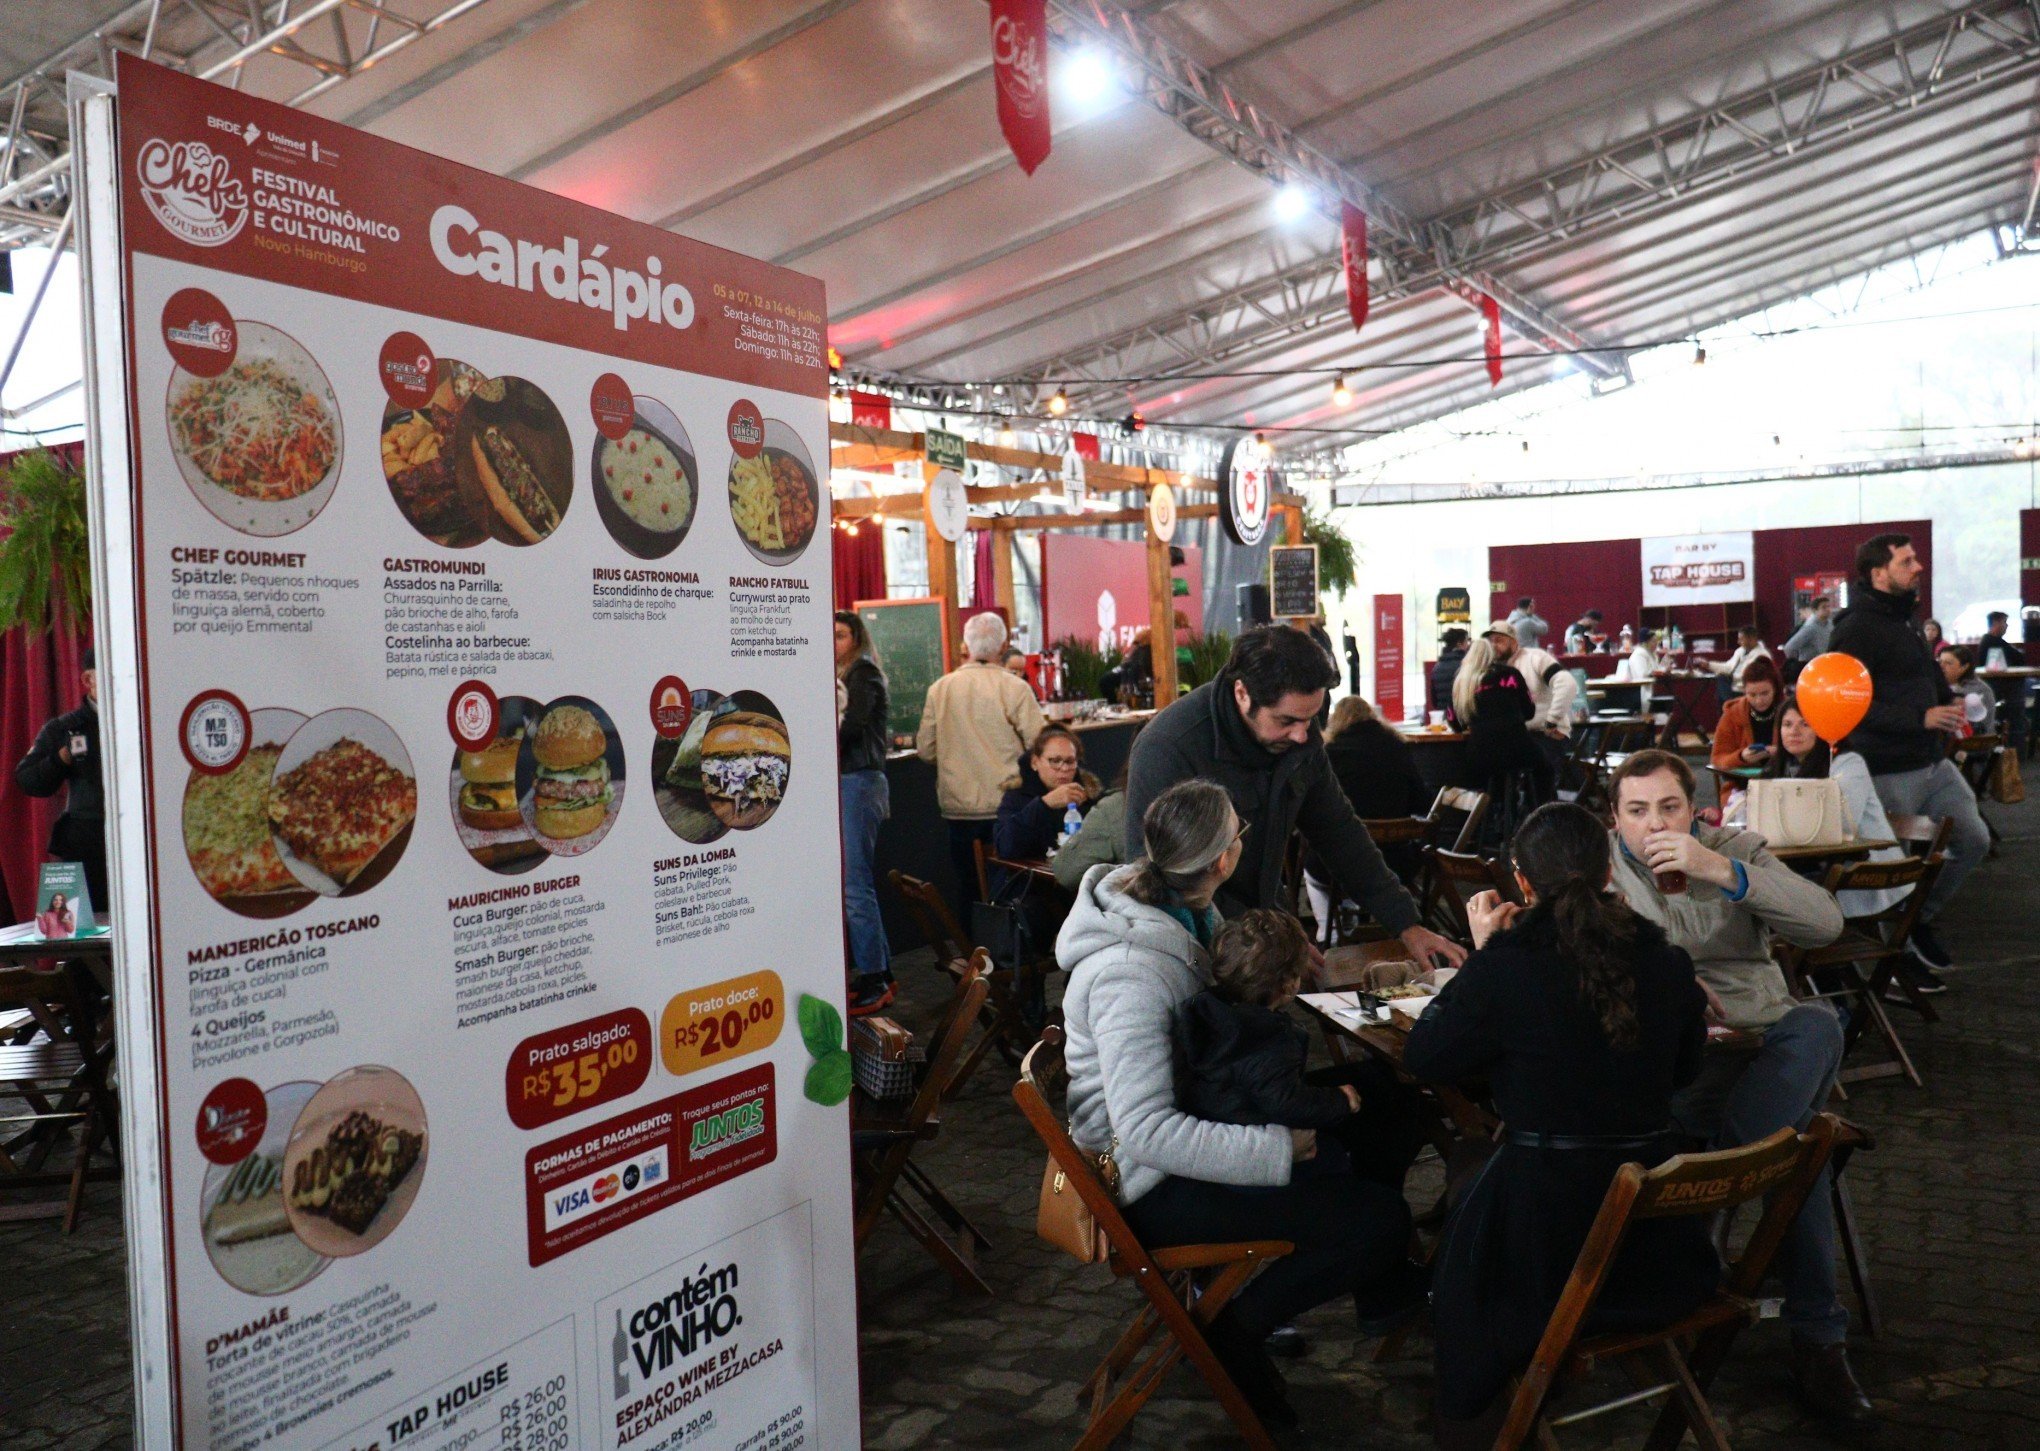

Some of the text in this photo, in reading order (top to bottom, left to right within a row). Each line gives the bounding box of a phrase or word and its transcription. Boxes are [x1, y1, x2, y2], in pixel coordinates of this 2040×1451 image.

[207, 115, 242, 136] BRDE
[267, 131, 306, 151] Unimed
[252, 167, 340, 207] FESTIVAL
[160, 204, 227, 239] GOURMET
[253, 188, 400, 243] GASTRONÔMICO
[254, 212, 366, 254] E CULTURAL
[254, 234, 367, 273] Novo Hamburgo
[429, 205, 695, 331] Cardápio
[713, 283, 822, 324] 05 a 07, 12 a 14 de julho
[724, 306, 820, 341] Sexta-feira: 17h às 22h;
[734, 338, 823, 368] Domingo: 11h às 22h.
[740, 325, 820, 355] Sábado: 11h às 22h;
[733, 425, 759, 442] RANCHO
[928, 434, 962, 457] SAÍDA
[171, 548, 306, 568] CHEF GOURMET
[383, 558, 486, 575] GASTROMUNDI
[1652, 563, 1743, 579] TAP HOUSE
[172, 570, 360, 591] Spätzle: Pequenos nhoques
[384, 577, 504, 592] Assados na Parrilla:
[592, 569, 700, 583] IRIUS GASTRONOMIA
[729, 577, 809, 589] RANCHO FATBULL
[172, 587, 320, 602] de massa, servido com
[384, 592, 510, 607] Churrasquinho de carne,
[592, 584, 714, 600] Escondidinho de charque:
[729, 592, 810, 605] Currywurst ao prato
[1441, 597, 1464, 610] BALY
[172, 603, 325, 618] linguiça alemã, coberto
[592, 610, 666, 620] com salsicha Bock
[174, 620, 312, 634] por queijo Emmental
[384, 635, 530, 648] Costelinha ao barbecue:
[730, 635, 808, 648] Acompanha batatinha
[730, 647, 756, 656] crinkle
[762, 646, 796, 656] mostarda
[653, 847, 736, 872] SUNS DA LOMBA
[654, 864, 737, 886] Suns Privilege: Pão
[448, 874, 580, 910] MAURICINHO BURGER
[453, 896, 585, 928] Cuca Burger: pão de cuca,
[187, 915, 380, 965] MANJERICÃO TOSCANO
[454, 933, 595, 972] Smash Burger: pão brioche,
[189, 969, 230, 985] Pizza
[245, 946, 326, 973] Germânica
[456, 984, 597, 1028] Acompanha batatinha crinkle
[690, 986, 759, 1016] Prato doce:
[190, 1012, 266, 1038] 4 Queijos
[529, 1024, 631, 1066] Prato salgado:
[682, 1086, 770, 1120] Troque seus pontos no:
[689, 1097, 764, 1151] JUNTOS
[534, 1114, 672, 1174] FORMAS DE PAGAMENTO:
[555, 1188, 589, 1216] VISA
[1655, 1177, 1735, 1201] JUNTOS
[630, 1262, 738, 1338] contém
[206, 1284, 390, 1372] Torta de vitrine: Casquinha
[206, 1306, 290, 1356] D'MAMÃE
[632, 1294, 742, 1380] VINHO.
[705, 1338, 783, 1394] MEZZACASA
[500, 1375, 565, 1423] R$ 26,00
[616, 1344, 738, 1428] ESPAÇO WINE BY
[386, 1362, 508, 1444] TAP HOUSE
[502, 1395, 566, 1444] R$ 26,00
[526, 1416, 568, 1450] 28,00
[671, 1410, 712, 1442] R$ 20,00
[736, 1406, 802, 1451] Garrafa R$ 90,00
